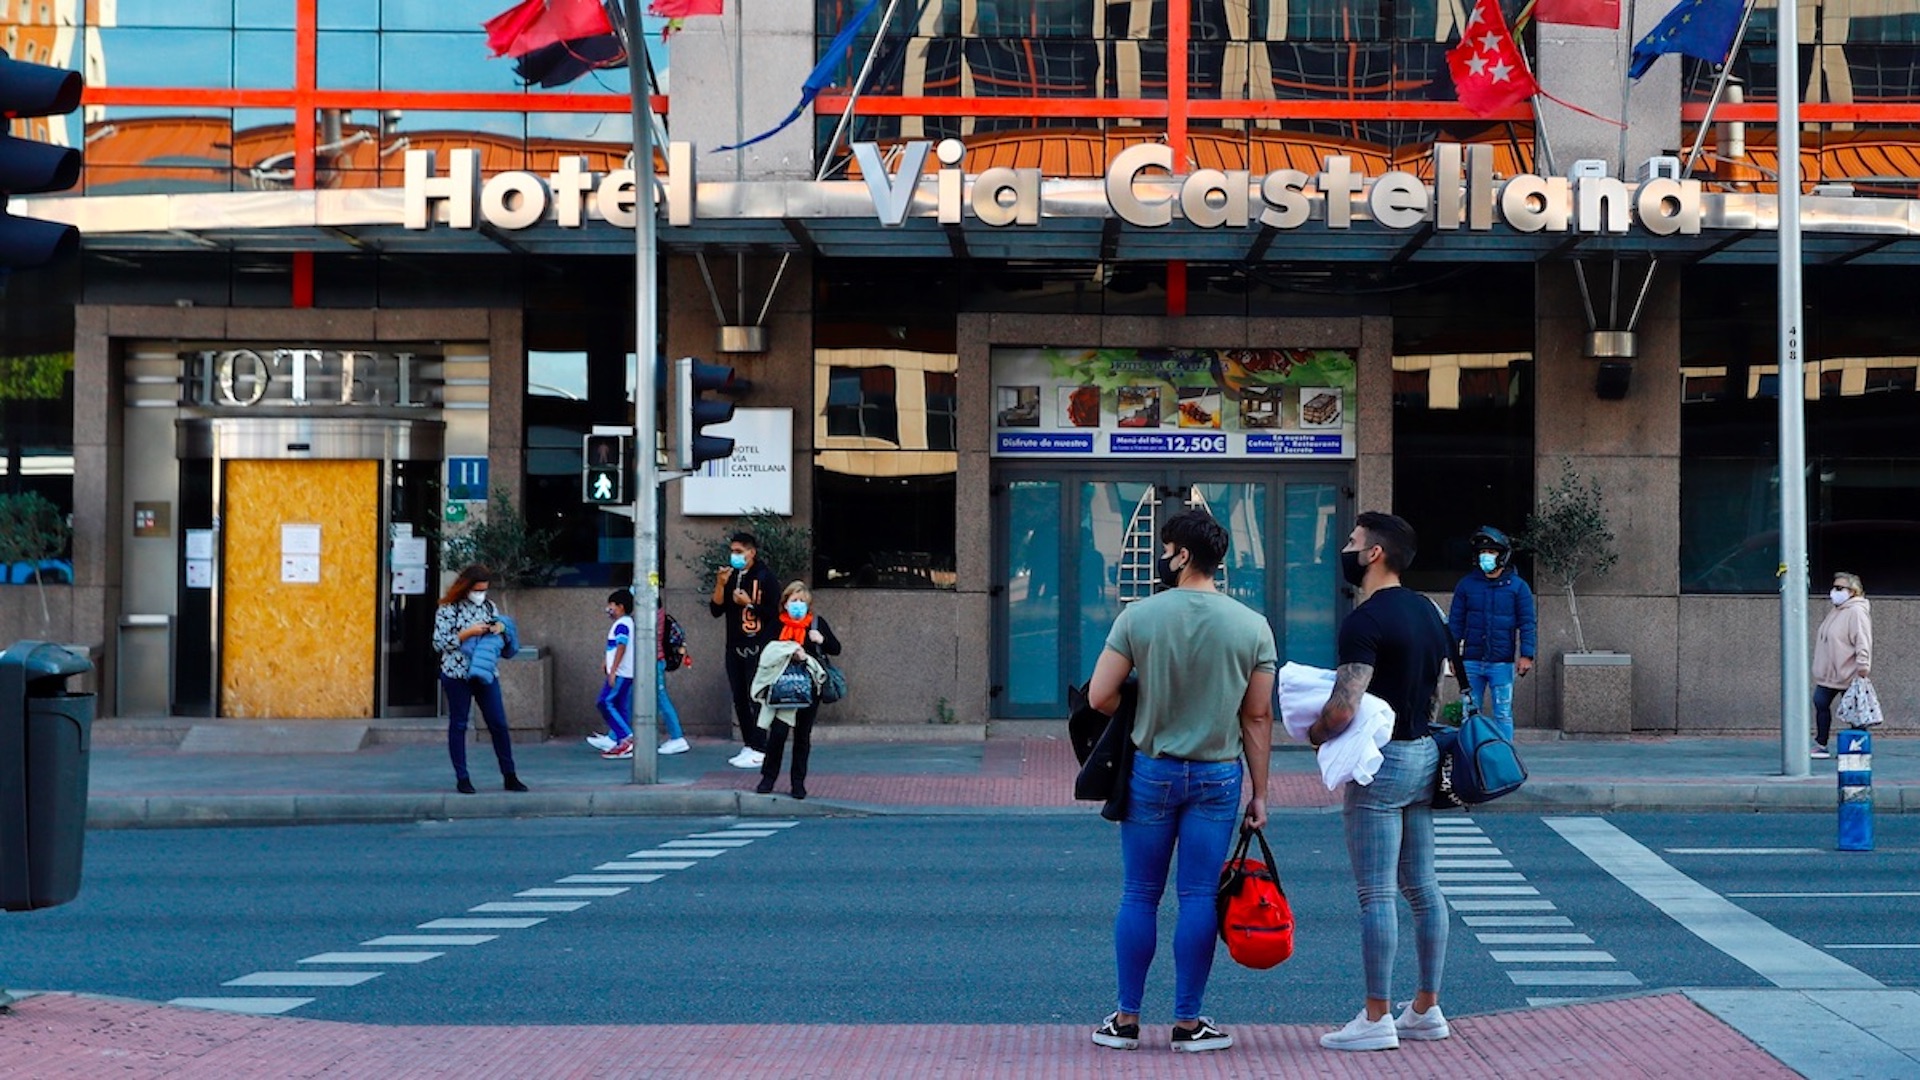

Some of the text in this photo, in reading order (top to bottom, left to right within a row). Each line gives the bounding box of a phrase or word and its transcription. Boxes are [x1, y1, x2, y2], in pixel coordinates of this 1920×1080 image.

[404, 138, 1701, 236] Hotel Via Castellana
[182, 348, 427, 407] HOTEL
[1002, 438, 1089, 448] Disfrute de nuestro
[1166, 436, 1225, 453] 12,50€
[731, 464, 786, 472] CASTELLANA
